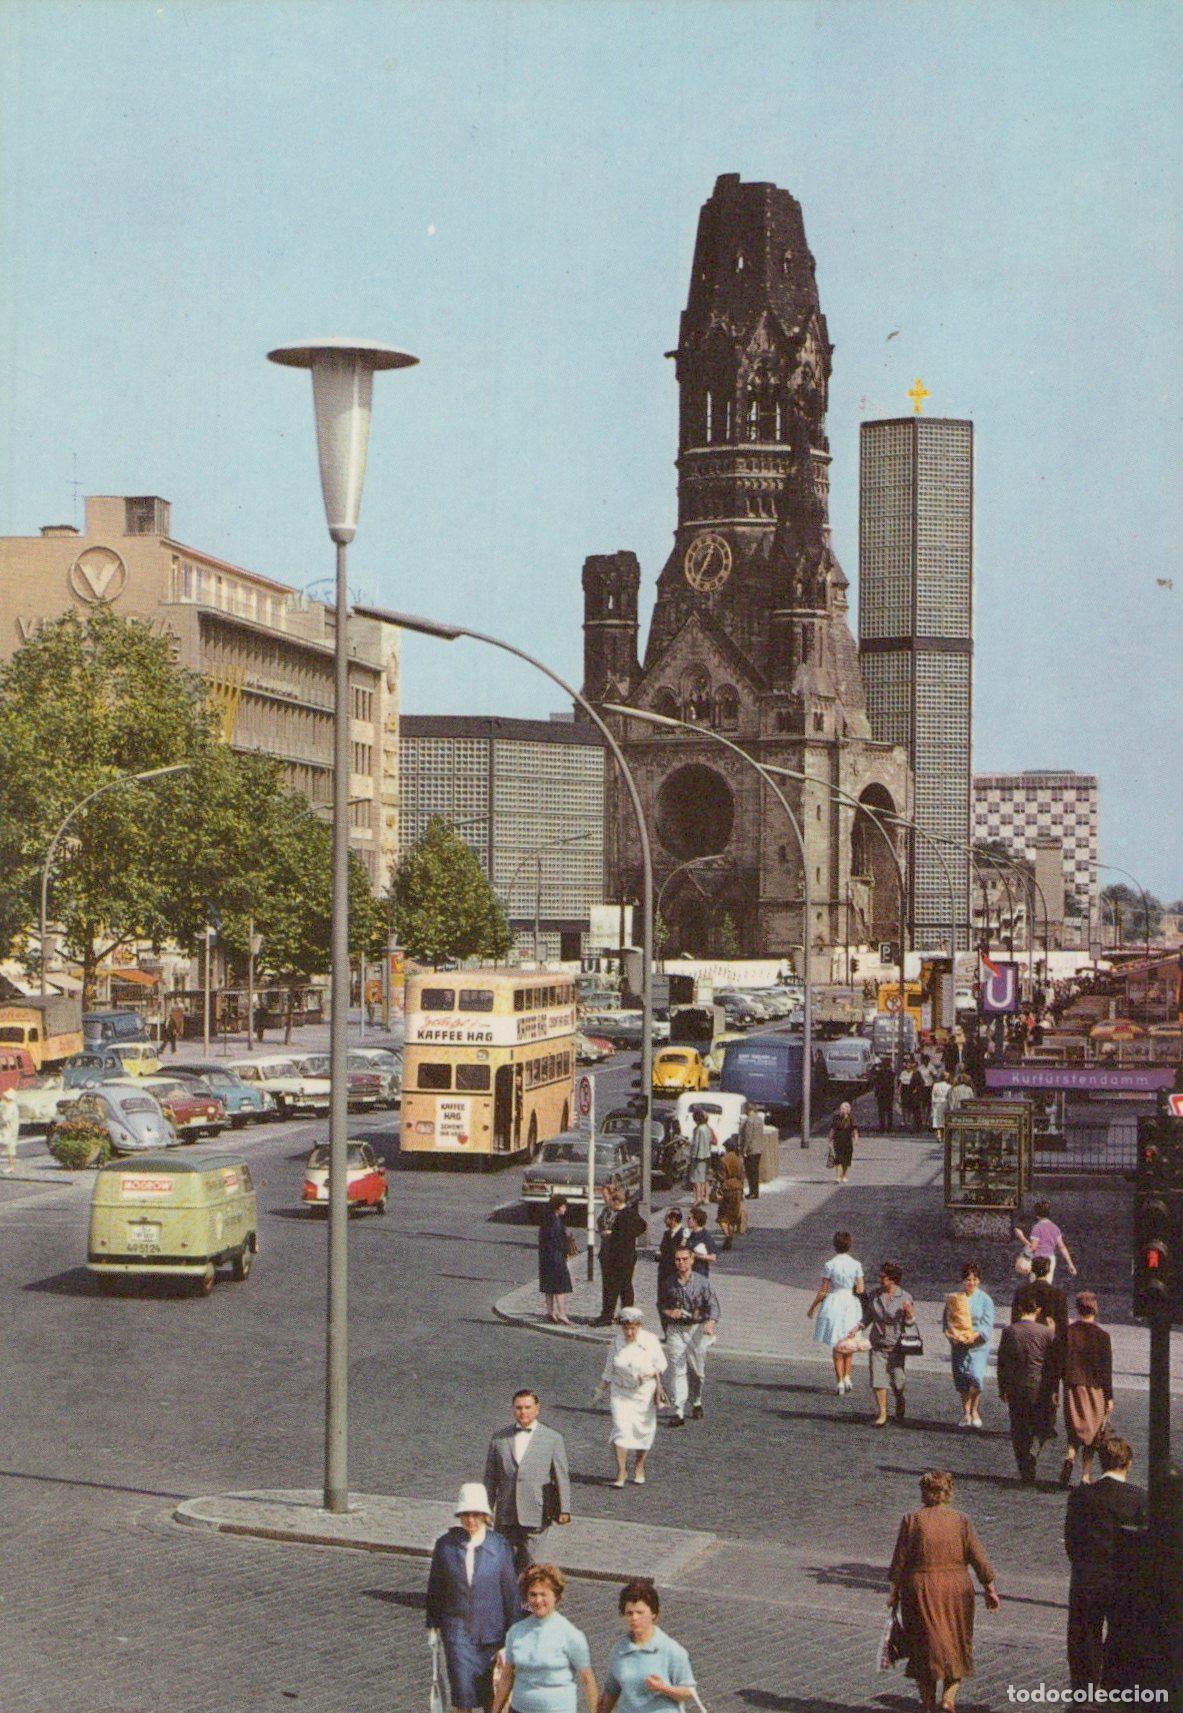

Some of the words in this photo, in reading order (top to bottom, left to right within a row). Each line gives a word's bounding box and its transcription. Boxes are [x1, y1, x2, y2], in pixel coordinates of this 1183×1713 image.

[882, 945, 891, 958] P
[986, 968, 1013, 1008] U
[417, 1030, 462, 1041] KAFFEE
[467, 1031, 493, 1042] HAG
[1012, 1072, 1149, 1086] Kurfürstendamm
[441, 1103, 465, 1112] KAFFEE
[444, 1112, 461, 1120] HAG
